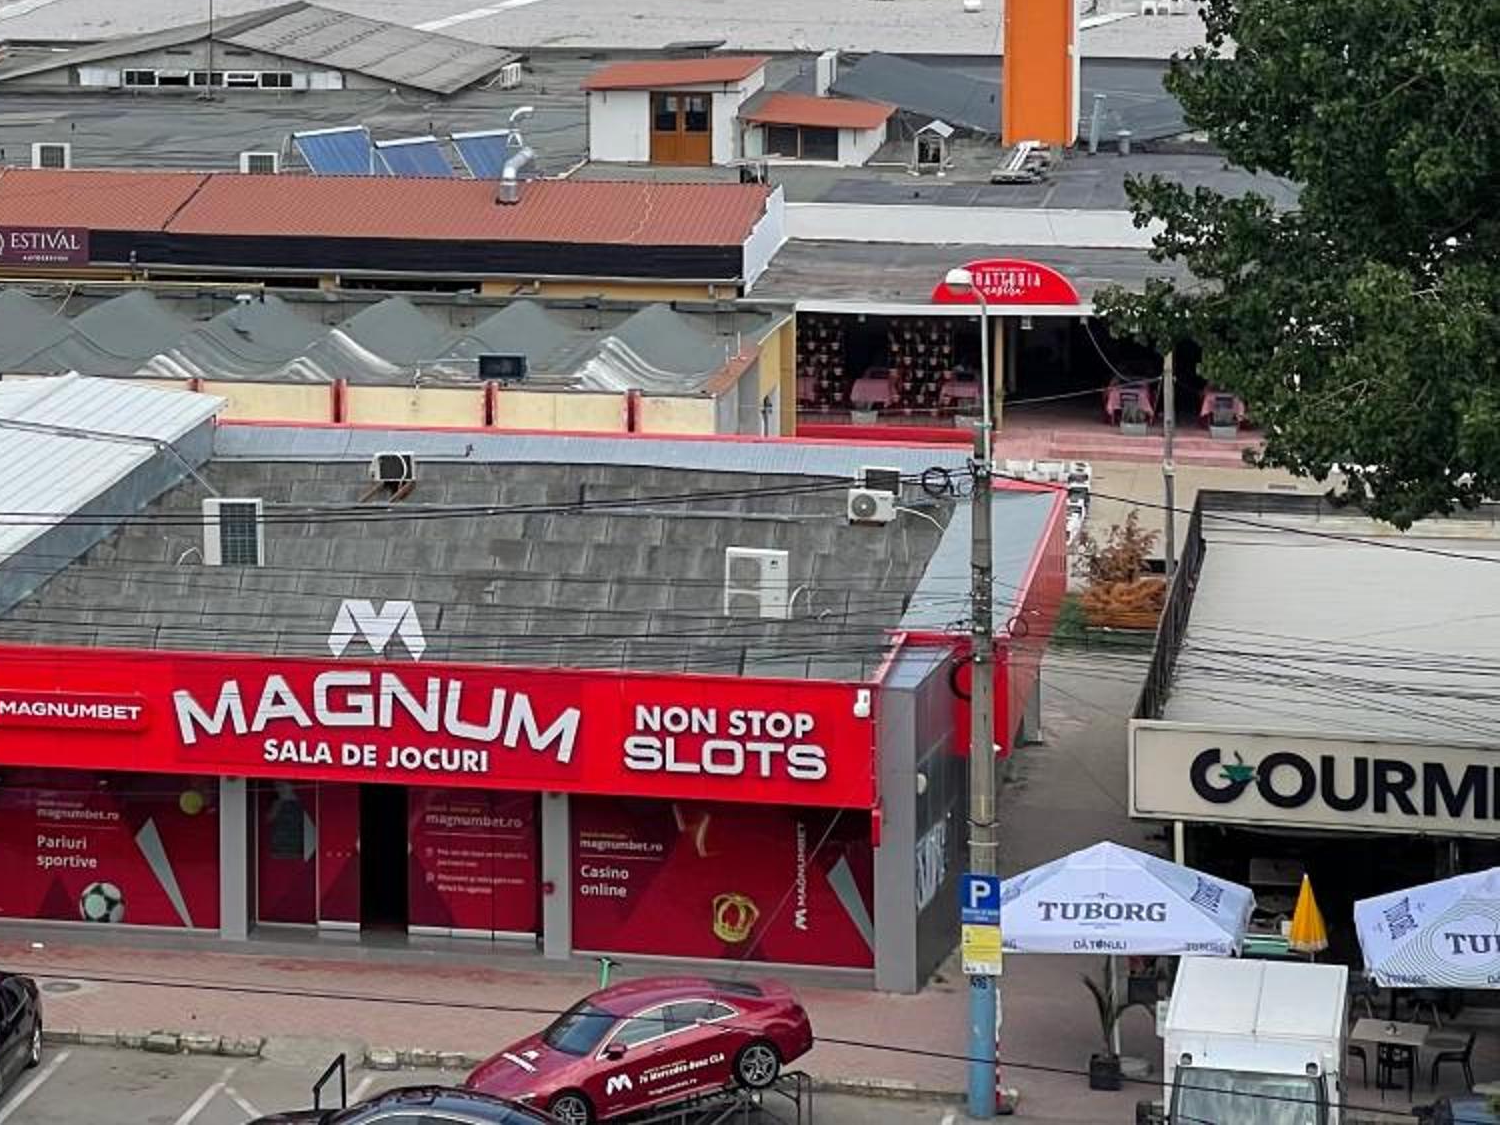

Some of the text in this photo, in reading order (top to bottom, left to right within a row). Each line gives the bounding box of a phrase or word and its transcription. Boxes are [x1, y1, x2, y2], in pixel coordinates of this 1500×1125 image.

[11, 230, 80, 250] ESTIVAL
[172, 669, 581, 764] MAGNUM
[635, 704, 815, 739] NON STOP
[264, 739, 489, 772] SALA DE JOCURI
[623, 735, 827, 780] SLOTS
[1190, 747, 1500, 820] GOURM
[36, 806, 120, 821] magnumbet.ro
[425, 814, 523, 828] magnumbet.ro
[36, 835, 87, 850] Pariuri
[580, 838, 663, 852] magnumbet.ro
[36, 853, 97, 870] sportive
[580, 865, 629, 880] Casino
[580, 883, 627, 897] online
[970, 880, 991, 908] P
[1038, 901, 1167, 922] TUBORG
[1443, 932, 1500, 954] TU
